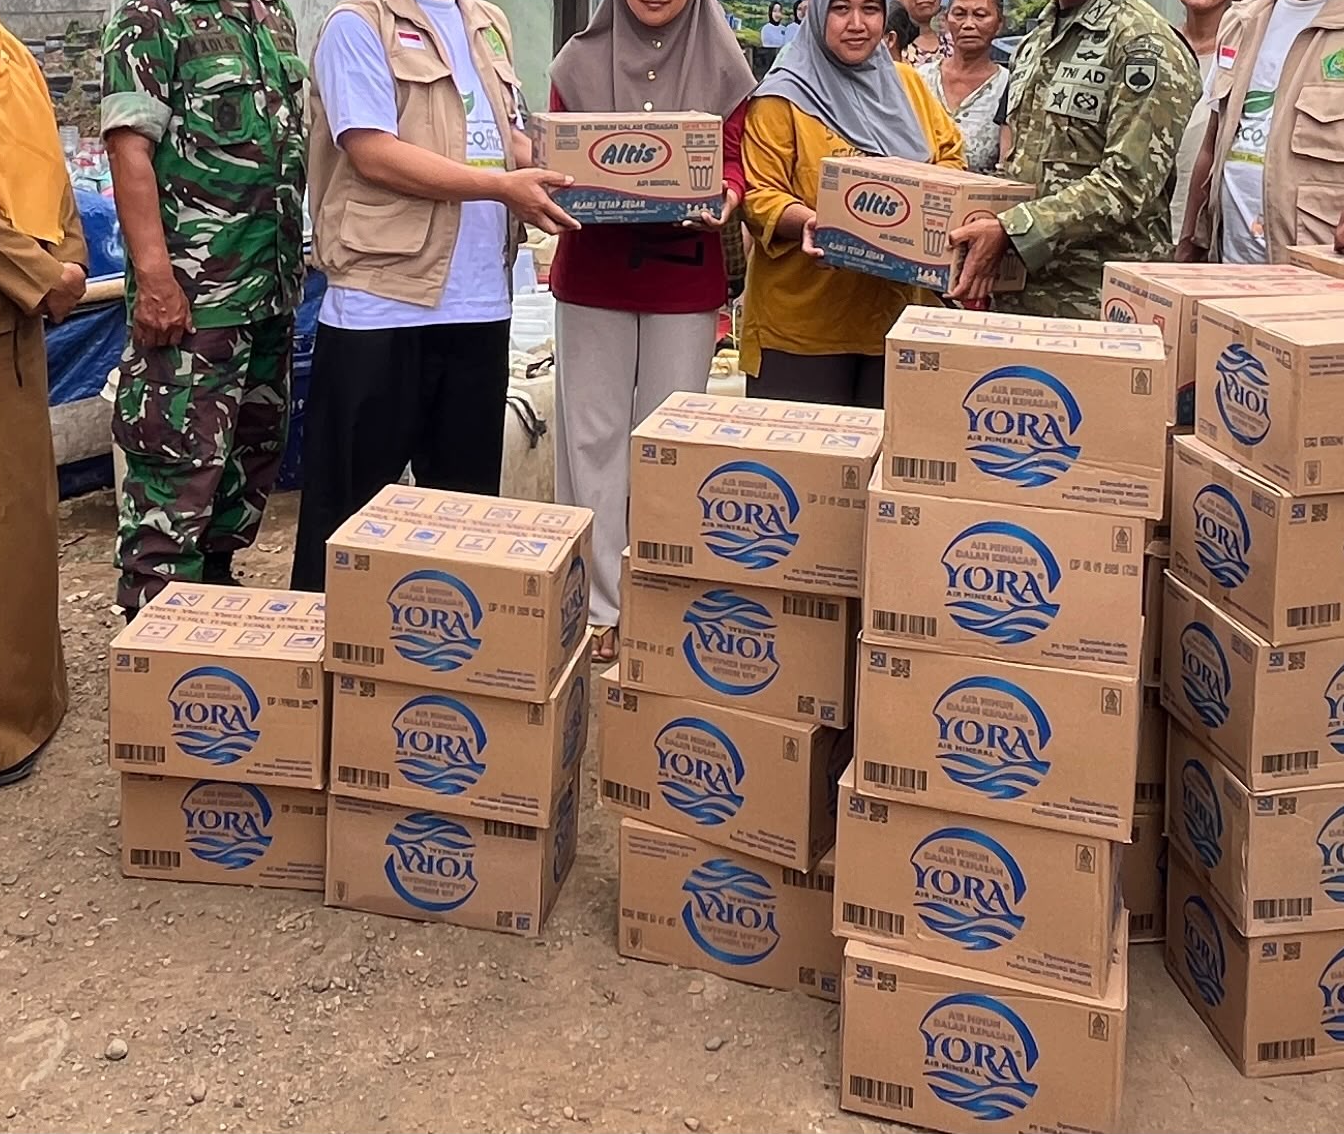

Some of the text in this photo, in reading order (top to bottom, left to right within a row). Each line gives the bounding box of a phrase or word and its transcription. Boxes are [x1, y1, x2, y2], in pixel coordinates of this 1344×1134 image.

[1061, 66, 1106, 84] TNI AD
[600, 143, 657, 165] Altis
[852, 190, 899, 217] Altis
[965, 407, 1067, 447] YORA
[985, 436, 1025, 446] MINERAL
[697, 497, 782, 537] YORA
[1195, 512, 1243, 564] YORA
[943, 564, 1046, 604] YORA
[945, 589, 1004, 603] AIR MINERAL
[387, 603, 468, 637] YORA
[696, 625, 776, 662] YORA
[1182, 650, 1226, 706] YORA
[170, 702, 246, 731] YORA
[394, 728, 471, 763] YORA
[936, 716, 1033, 760] YORA
[937, 742, 994, 758] AIR MINERAL
[655, 749, 732, 791] YORA
[183, 809, 259, 840] YORA
[396, 844, 474, 880] YORA
[914, 863, 1009, 915] YORA
[914, 890, 970, 908] AIR MINERAL
[691, 891, 775, 929] YORA
[923, 1029, 1026, 1082] YORA
[924, 1058, 981, 1077] AIR MINERAL
